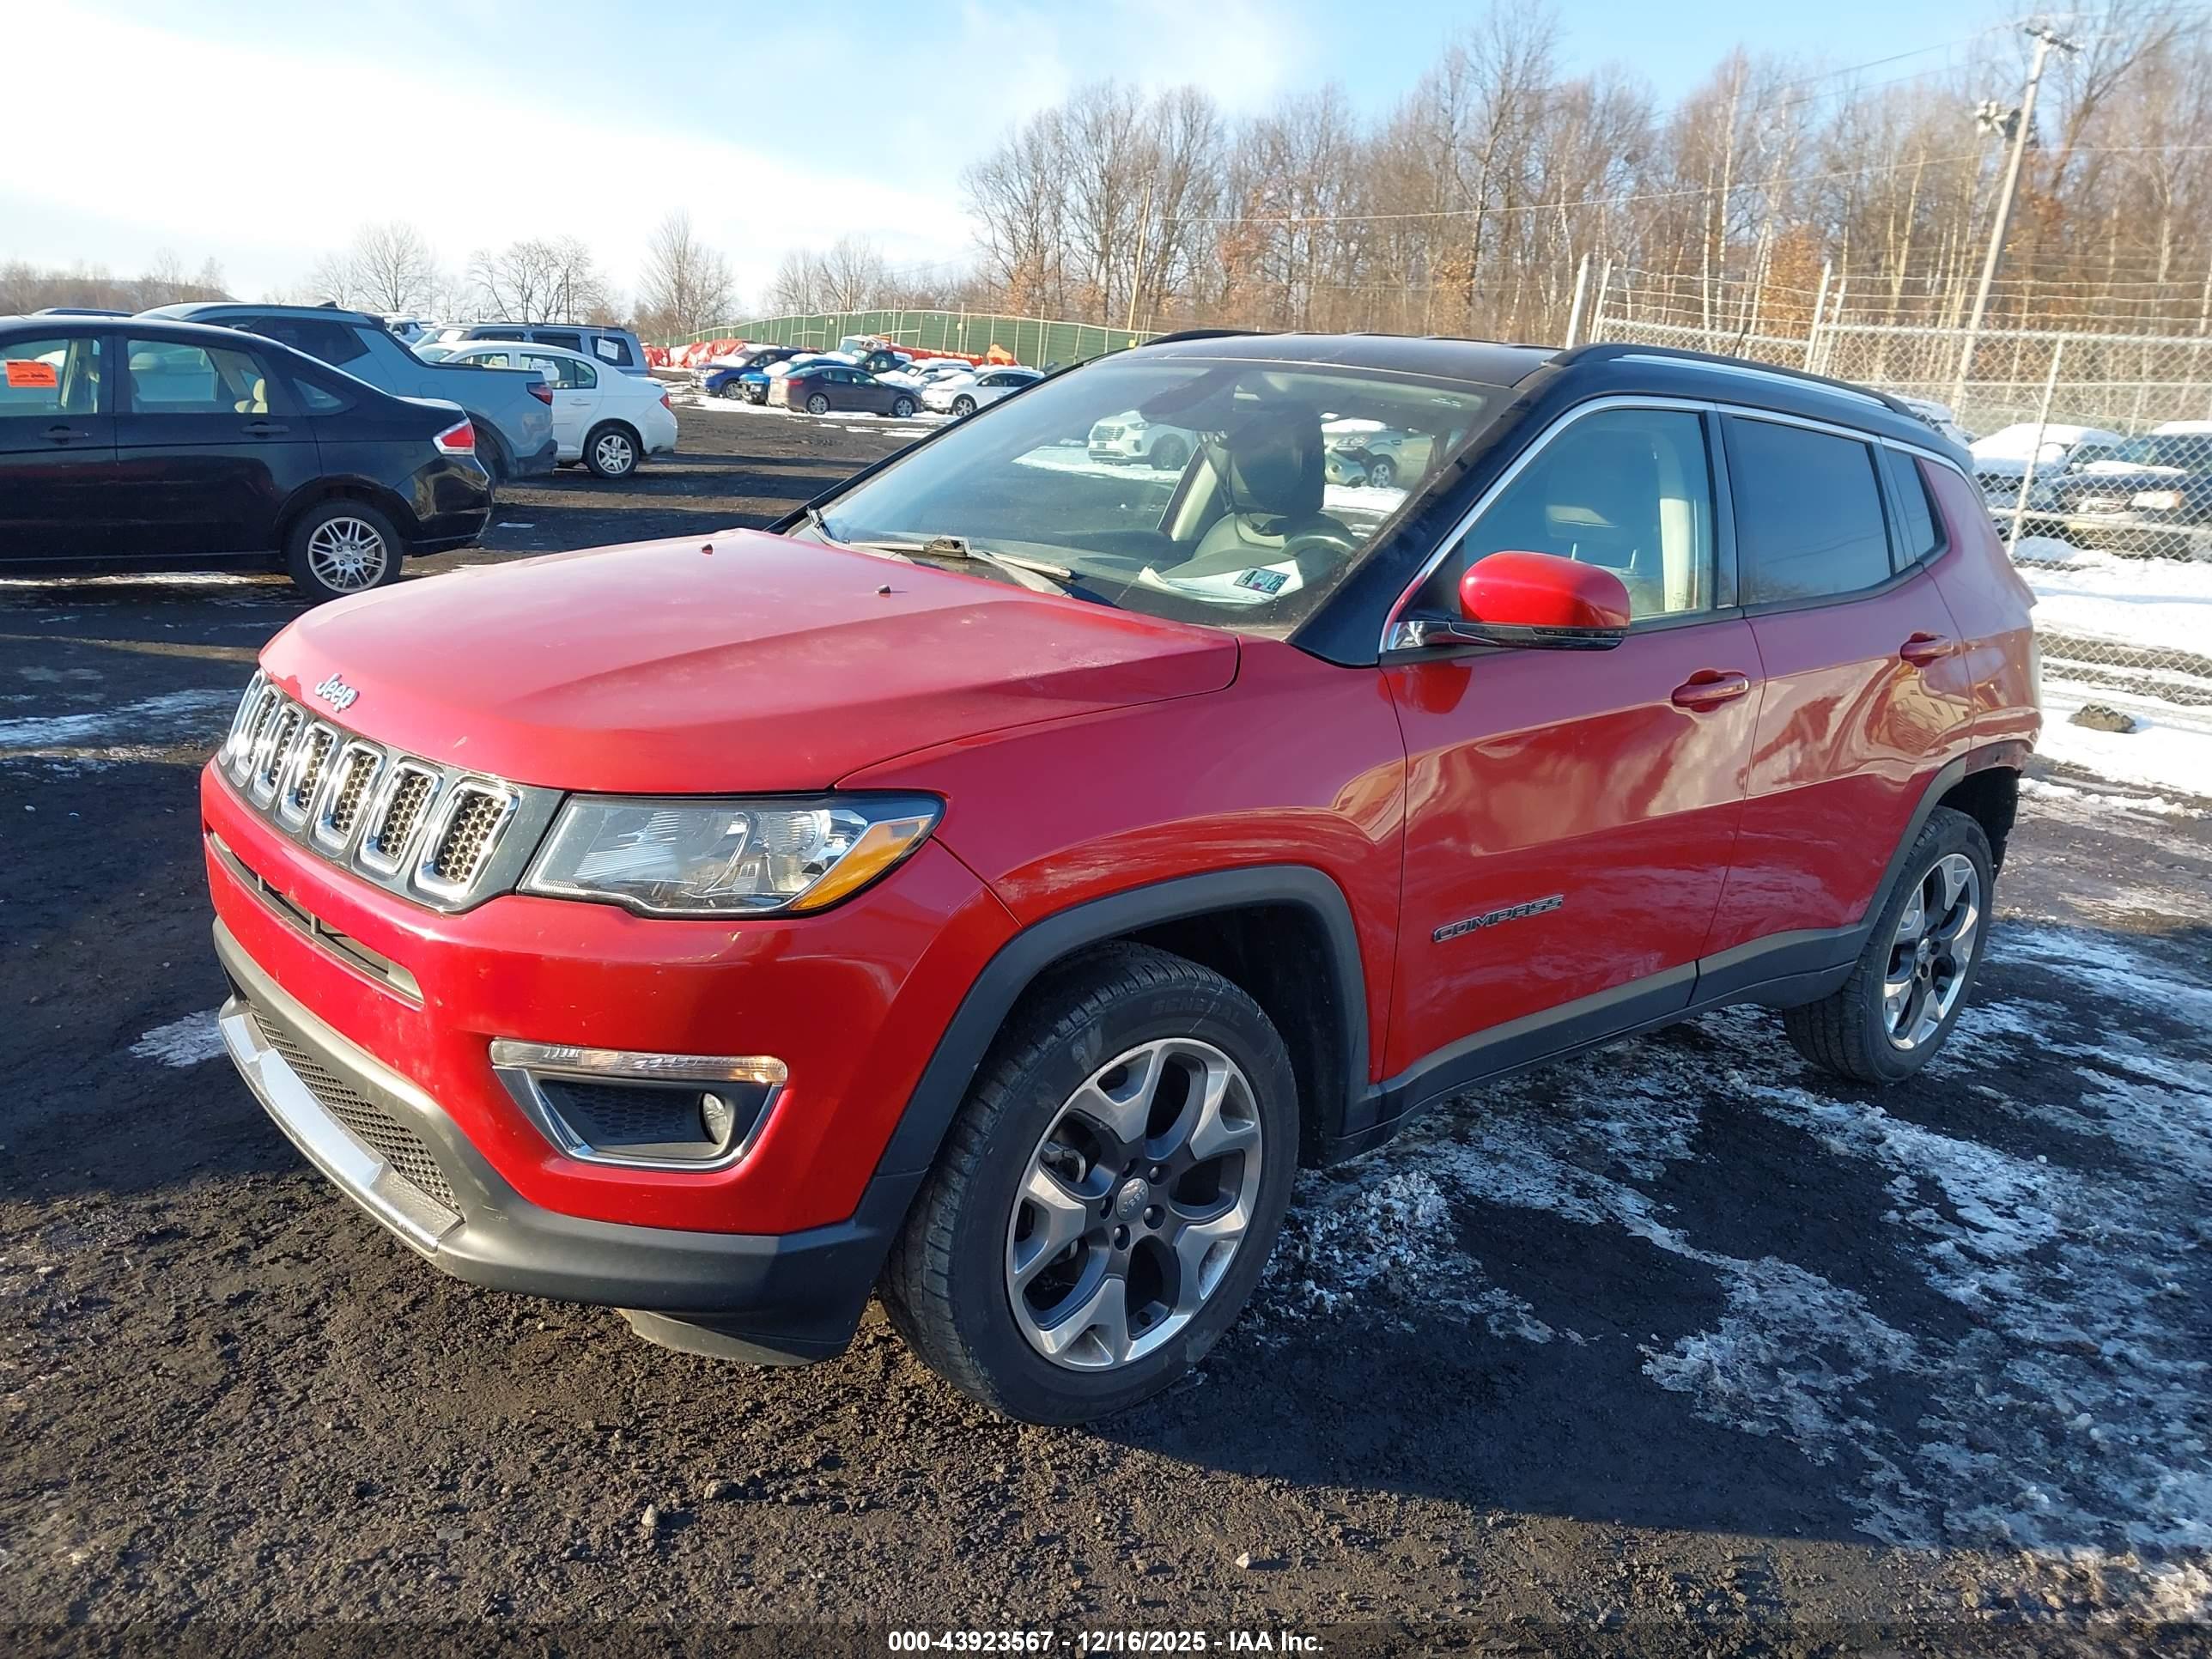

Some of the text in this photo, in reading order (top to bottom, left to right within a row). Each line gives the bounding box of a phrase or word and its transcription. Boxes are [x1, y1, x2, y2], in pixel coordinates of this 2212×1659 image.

[1242, 570, 1258, 586] 4
[314, 673, 360, 714] Jeep
[1431, 894, 1565, 943] COMPASS
